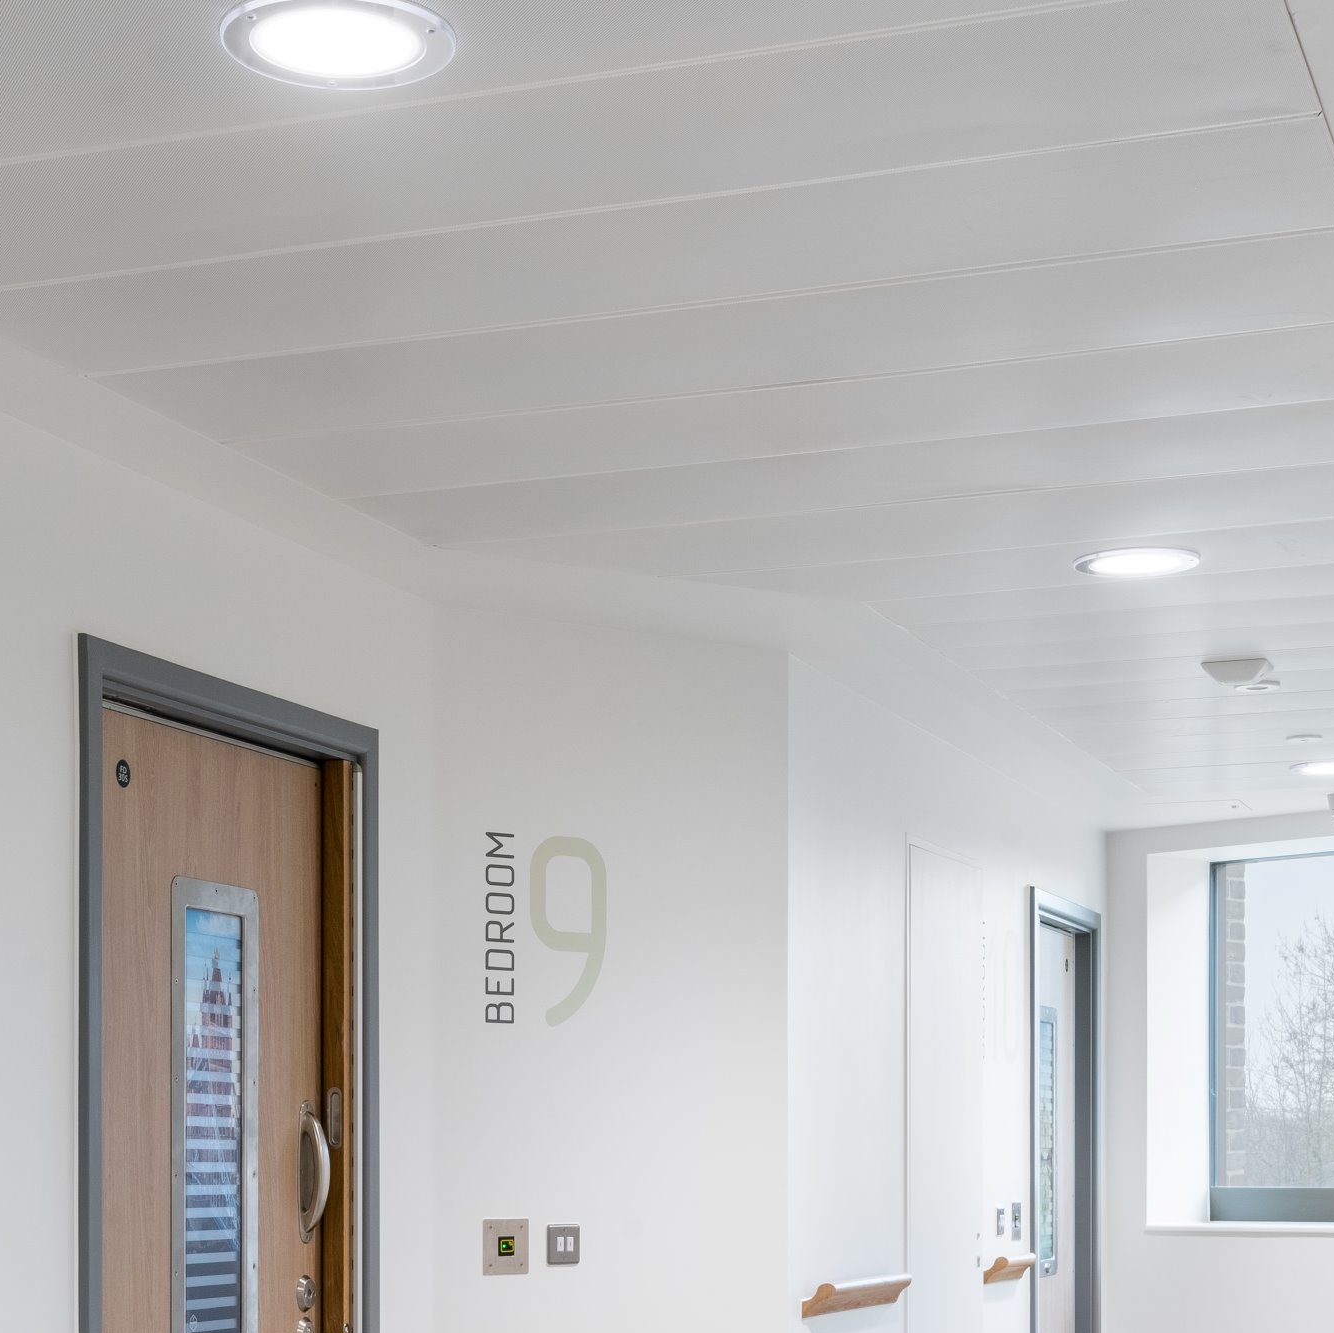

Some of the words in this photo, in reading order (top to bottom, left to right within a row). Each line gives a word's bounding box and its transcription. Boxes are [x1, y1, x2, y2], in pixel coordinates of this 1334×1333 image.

[120, 766, 128, 774] FD
[485, 831, 515, 1024] BEDROOM
[529, 835, 607, 1028] 9
